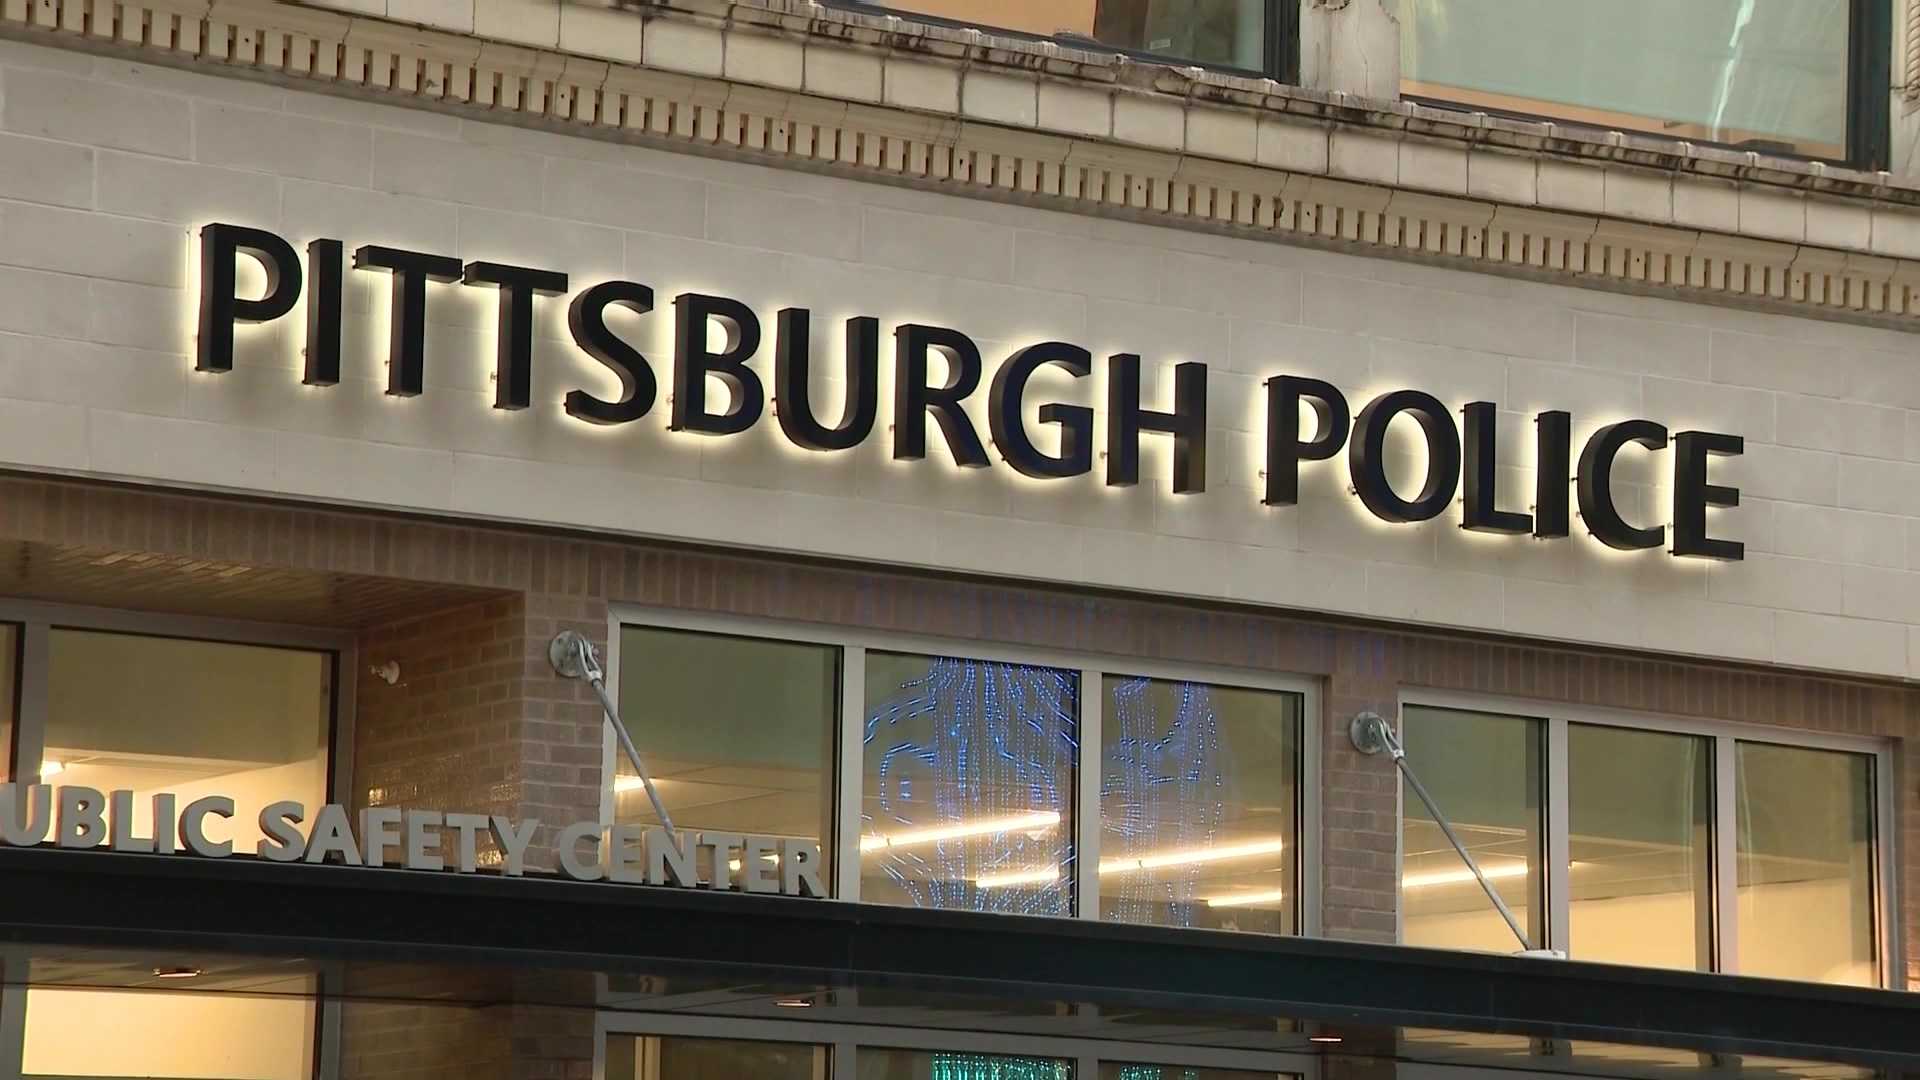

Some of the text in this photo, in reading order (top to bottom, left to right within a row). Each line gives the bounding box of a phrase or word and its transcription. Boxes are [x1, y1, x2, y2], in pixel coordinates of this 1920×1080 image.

[198, 222, 1744, 561] PITTSBURGH POLICE
[0, 783, 829, 897] UBLIC SAFETY CENTER
